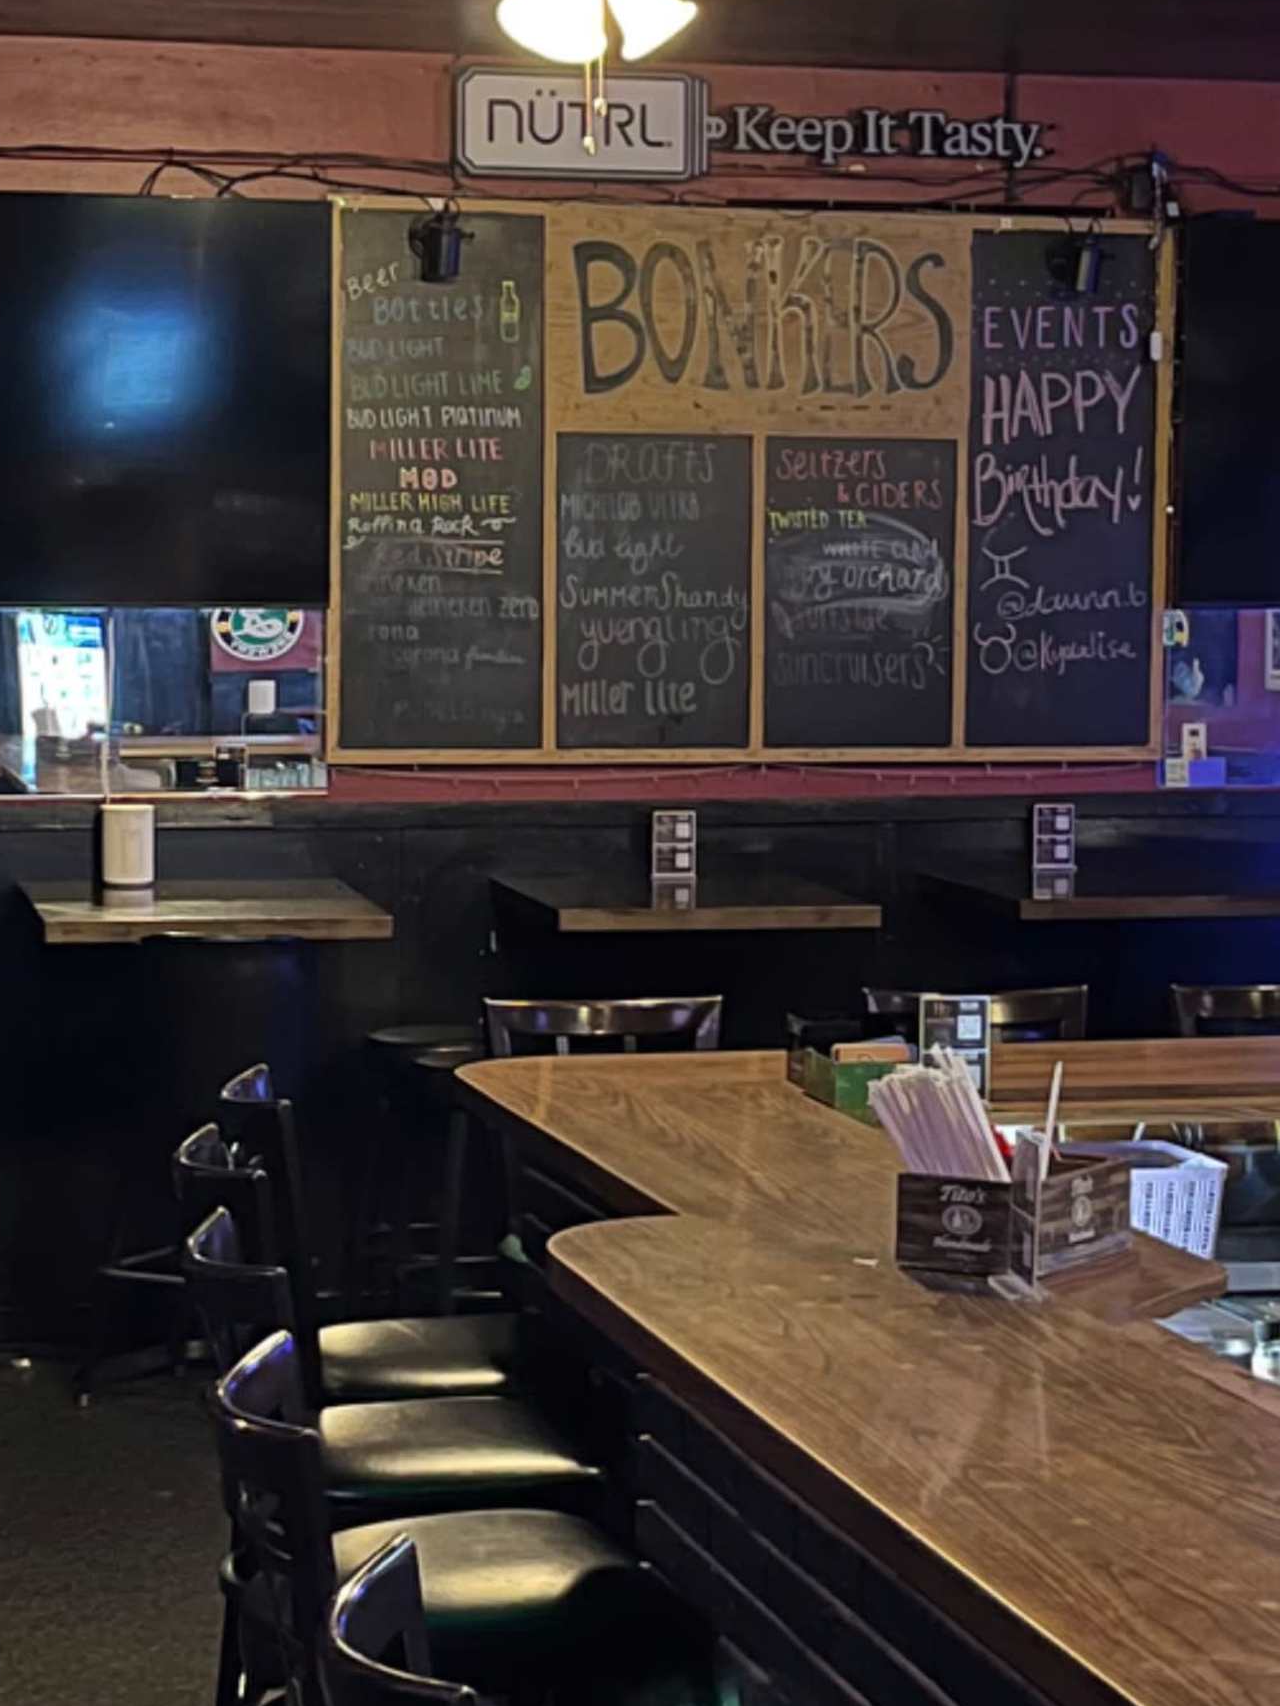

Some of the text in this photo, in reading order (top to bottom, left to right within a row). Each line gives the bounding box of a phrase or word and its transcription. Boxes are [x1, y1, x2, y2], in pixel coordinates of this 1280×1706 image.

[733, 105, 1046, 168] Keep It Tasty.
[346, 261, 400, 301] Beer
[571, 234, 956, 396] BONKERS
[984, 303, 1140, 350] EVENTS
[390, 337, 445, 359] LIGHT
[390, 371, 449, 399] LIGHT
[459, 370, 505, 395] LIME
[379, 406, 432, 430] LIGHT
[982, 364, 1142, 446] HAPPY
[369, 438, 504, 461] MILLER LITE
[349, 493, 512, 515] MILLER HIGH LIFE
[854, 477, 944, 510] CIDERS
